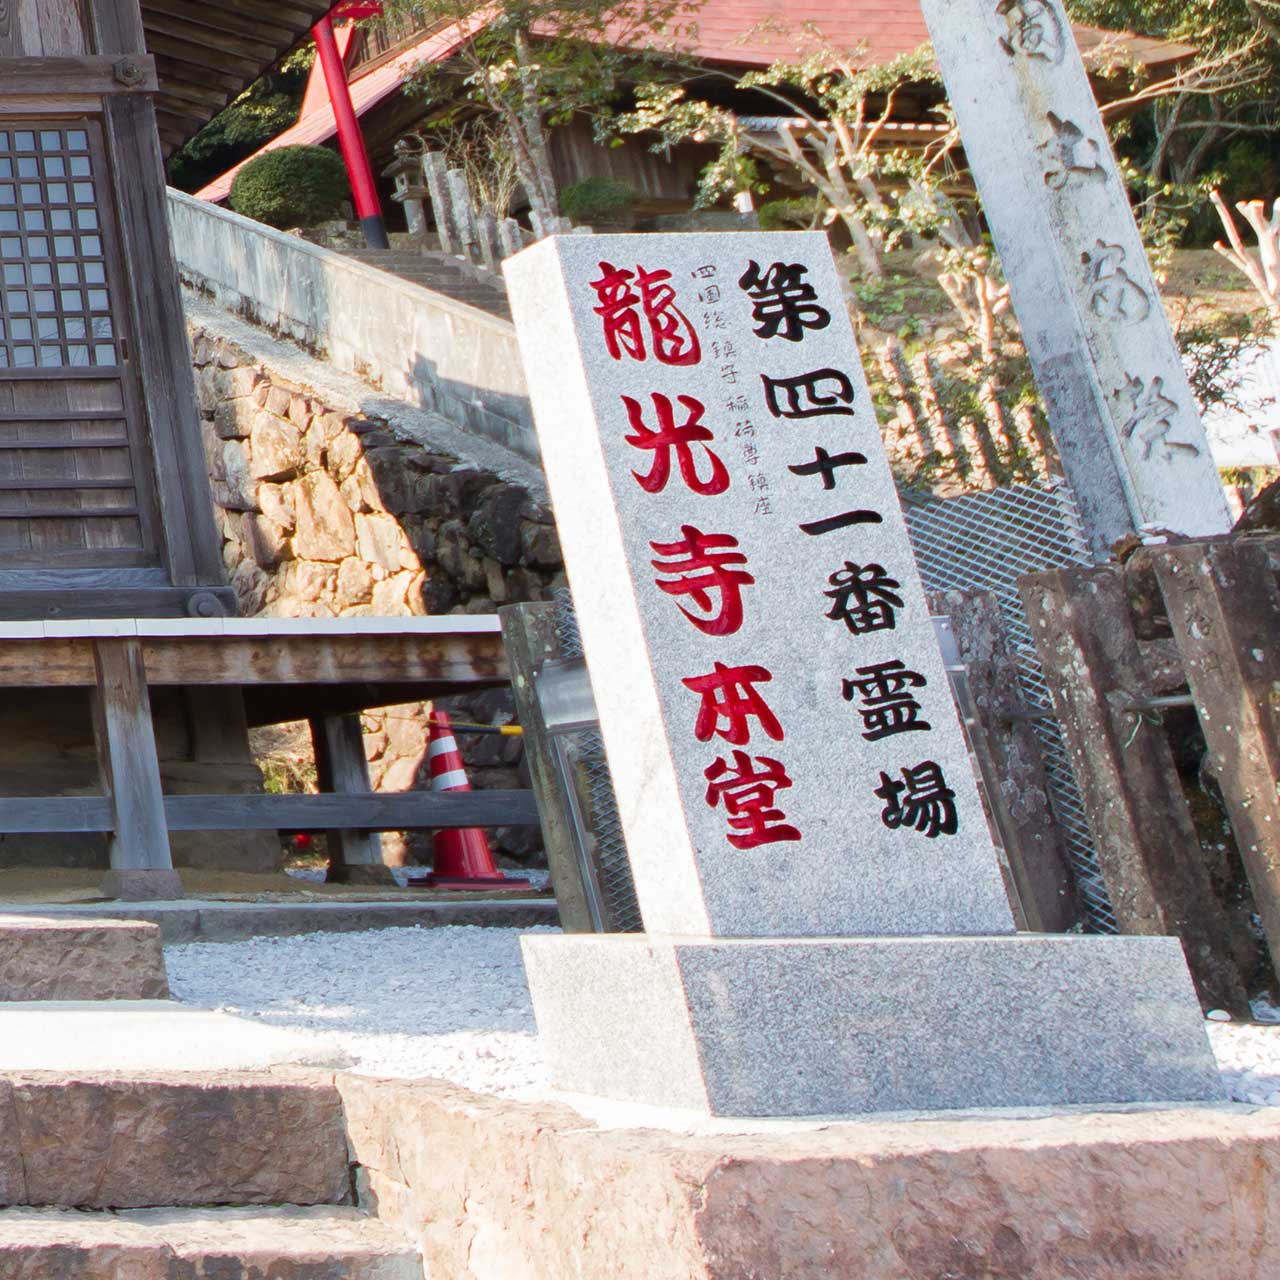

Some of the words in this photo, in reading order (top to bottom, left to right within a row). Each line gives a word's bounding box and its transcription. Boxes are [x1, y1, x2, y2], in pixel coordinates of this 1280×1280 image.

[593, 261, 804, 851] 龍光寺本堂
[739, 259, 959, 839] 第四十一番霊場
